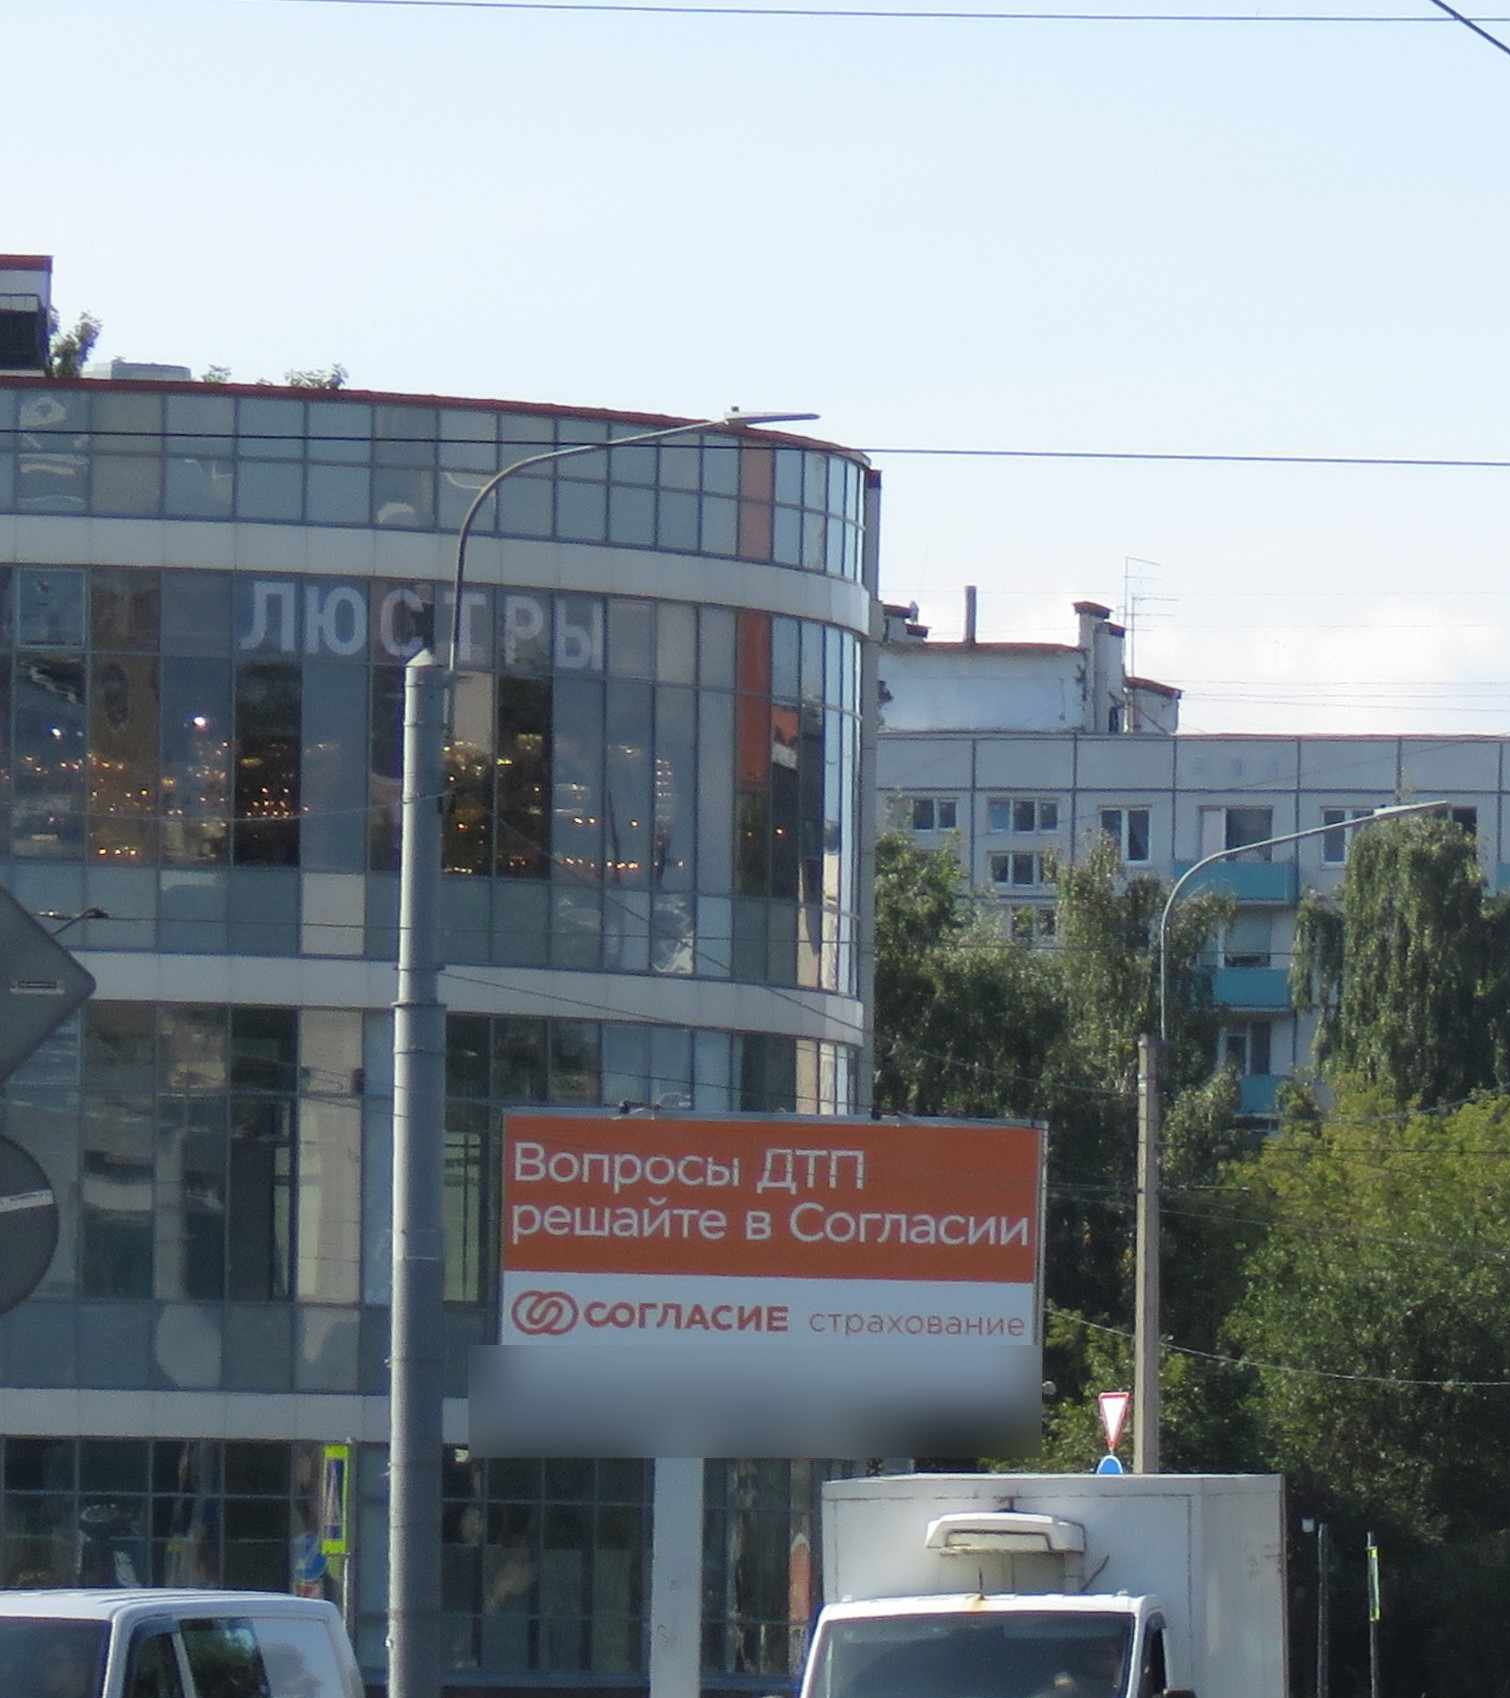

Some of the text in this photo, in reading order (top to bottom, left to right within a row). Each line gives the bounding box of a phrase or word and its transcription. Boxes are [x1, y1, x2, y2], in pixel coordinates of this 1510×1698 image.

[239, 581, 604, 671] ЛЮСТРЫ
[514, 1142, 865, 1195] Вопросы ДТП
[511, 1197, 1030, 1247] решайте в Согласии
[584, 1300, 1026, 1338] СОГЛАСИЕ страхование
